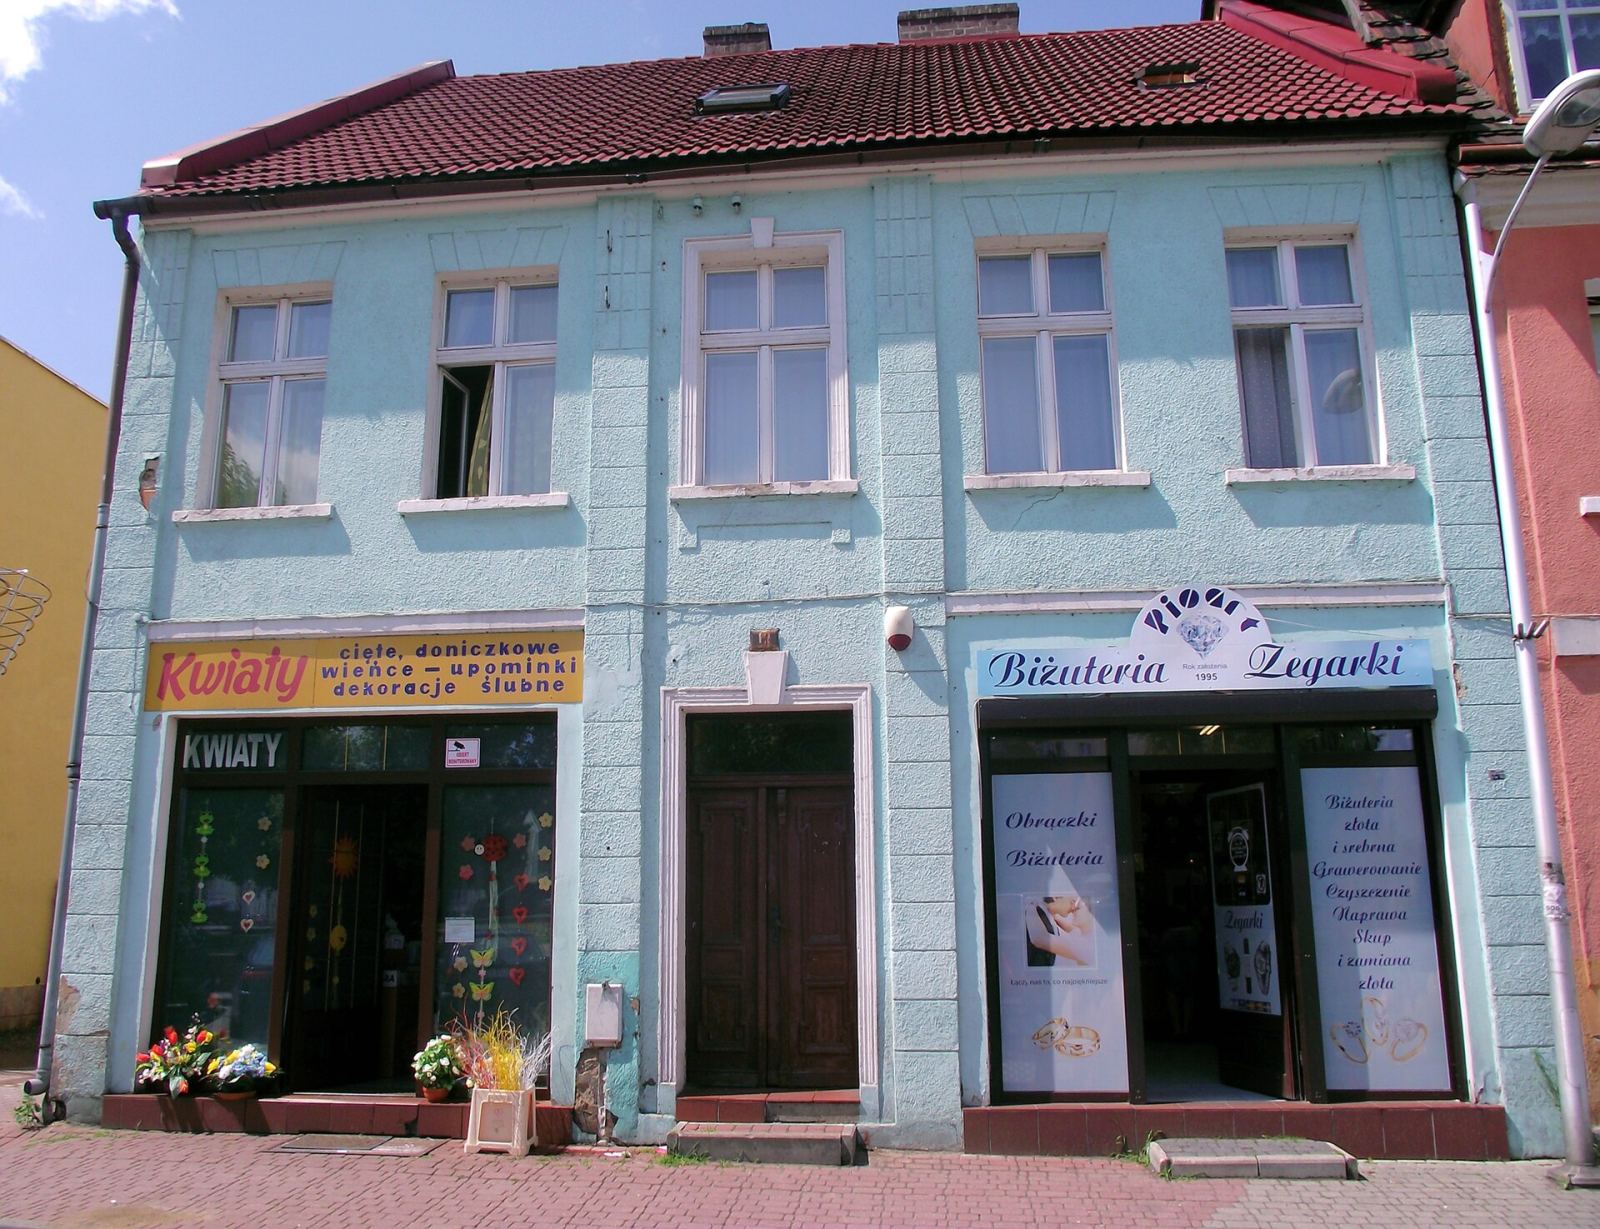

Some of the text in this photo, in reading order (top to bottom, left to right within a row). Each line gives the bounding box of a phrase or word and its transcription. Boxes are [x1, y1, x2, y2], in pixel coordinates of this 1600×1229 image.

[339, 640, 560, 664] cięte, doniczkowe
[321, 661, 414, 679] wieńce
[450, 657, 577, 677] upominki
[988, 651, 1170, 688] Biżuteria
[1243, 641, 1406, 687] Zegarki
[156, 645, 309, 703] Kwiaty
[1195, 672, 1218, 681] 1995
[333, 675, 565, 699] dekoracje ślubne
[182, 732, 282, 769] KWIATY
[1324, 794, 1394, 810] Biżuteria
[1006, 811, 1098, 830] Obrączki
[1344, 816, 1379, 831] złota
[1341, 839, 1396, 853] srebrna
[1006, 850, 1104, 867] Biżuteria
[1311, 861, 1423, 879] Grawerowanie
[1326, 883, 1411, 901] Czyszczenie
[1224, 910, 1264, 933] Zegarki
[1332, 906, 1408, 924] Naprawa
[1352, 929, 1392, 947] Skup
[1347, 952, 1411, 966] zamiana
[1358, 974, 1394, 990] złota
